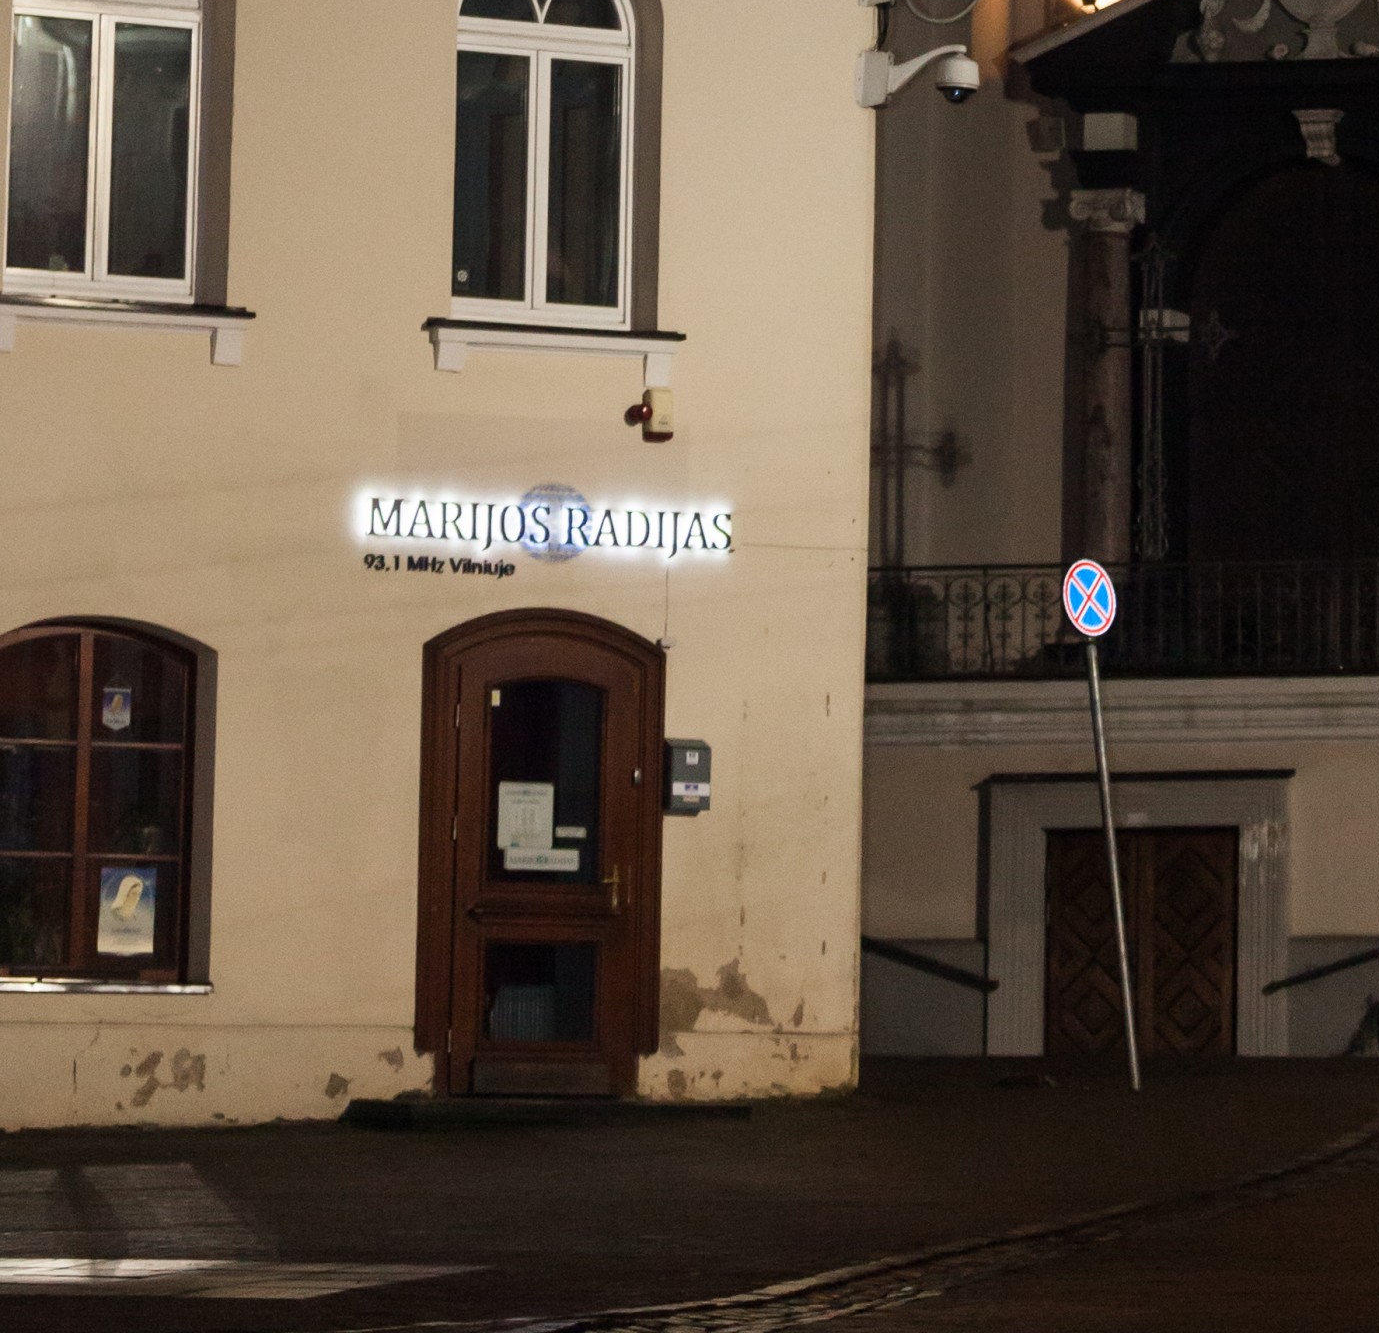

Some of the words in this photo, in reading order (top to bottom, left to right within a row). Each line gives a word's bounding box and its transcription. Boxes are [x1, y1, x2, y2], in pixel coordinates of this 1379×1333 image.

[368, 497, 550, 551] MARIJOS
[565, 506, 732, 558] RADIJAS
[406, 555, 446, 574] MHz
[449, 558, 516, 579] Vilniuje
